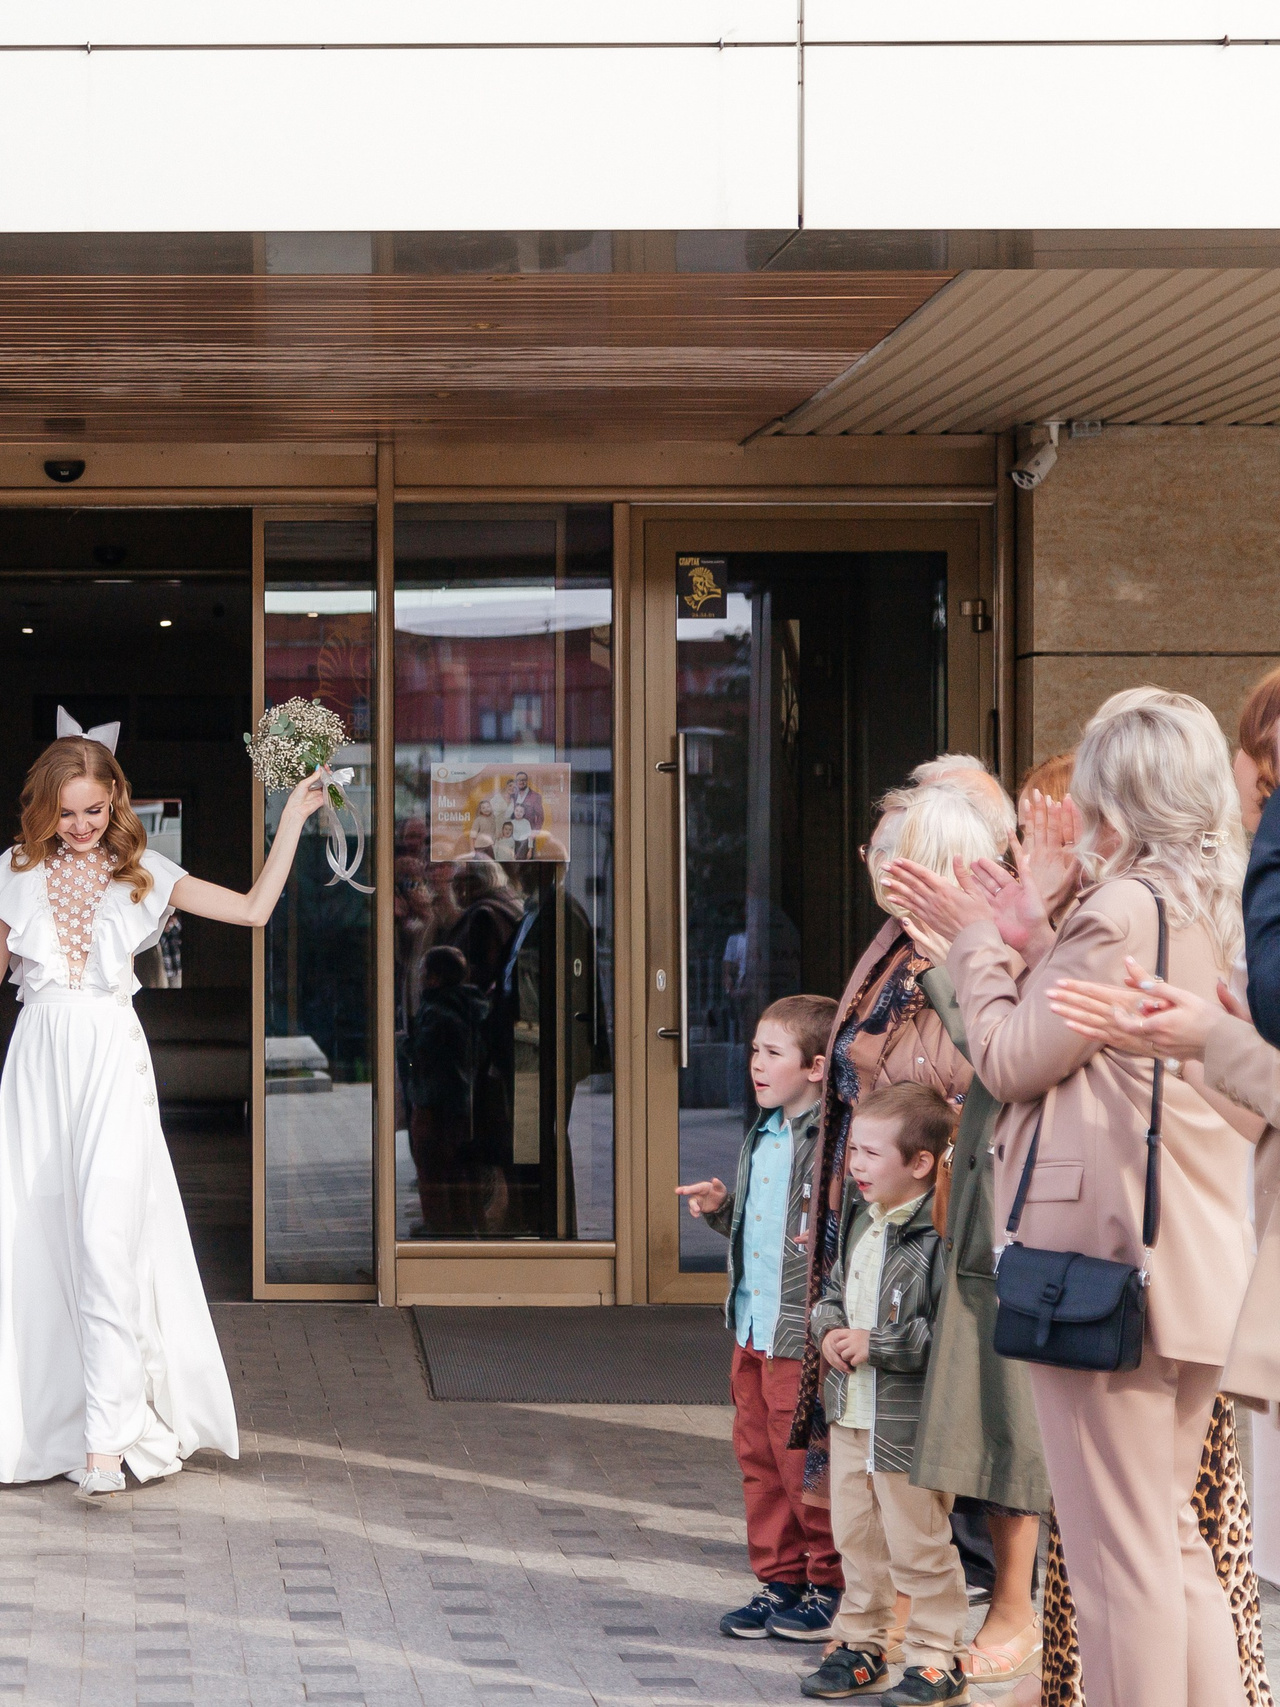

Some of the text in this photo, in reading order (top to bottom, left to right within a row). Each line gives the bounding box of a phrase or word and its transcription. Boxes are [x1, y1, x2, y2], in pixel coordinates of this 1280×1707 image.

[438, 795, 456, 808] Мы
[438, 812, 471, 822] семья
[854, 1667, 871, 1686] N
[920, 1666, 945, 1684] N
